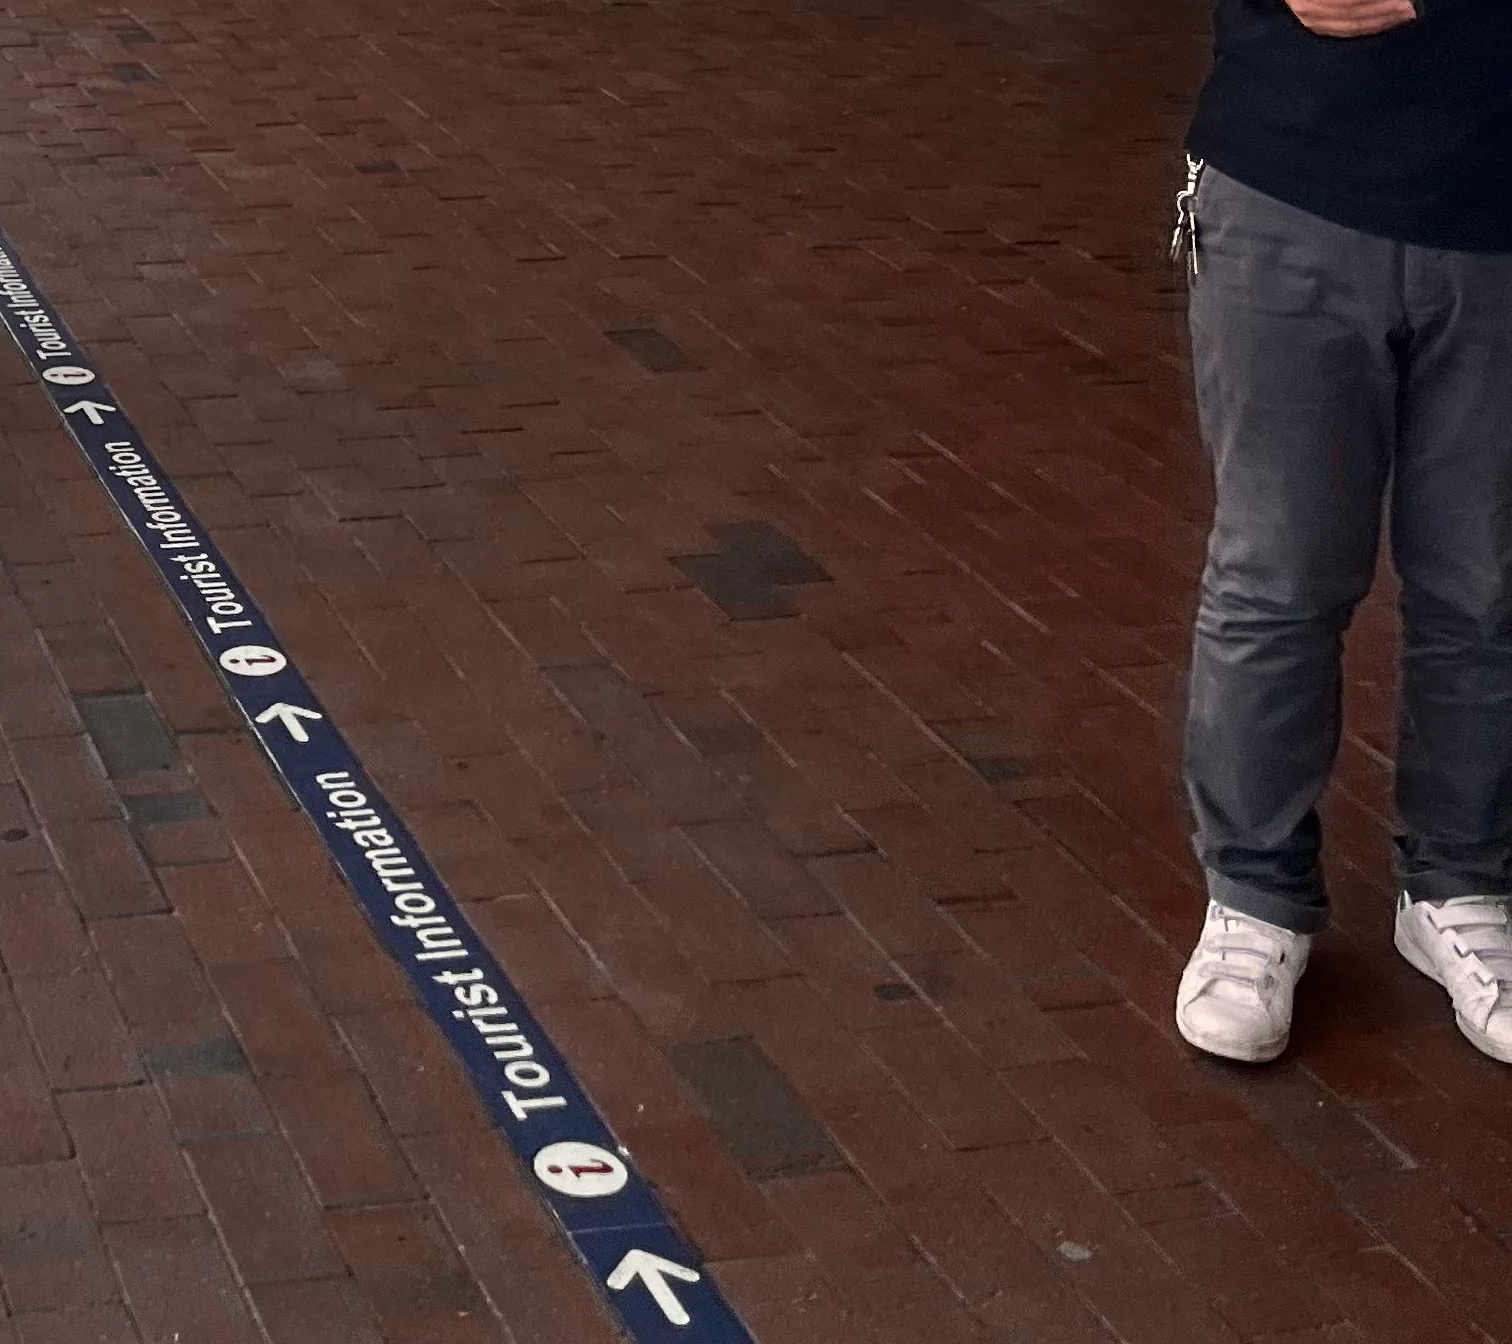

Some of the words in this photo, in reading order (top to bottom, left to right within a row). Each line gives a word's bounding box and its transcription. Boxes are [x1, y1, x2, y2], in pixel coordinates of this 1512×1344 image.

[13, 309, 72, 360] Tourist
[104, 441, 200, 550] Information
[170, 552, 252, 634] Tourist
[315, 770, 470, 964] Information
[432, 965, 568, 1122] Tourist
